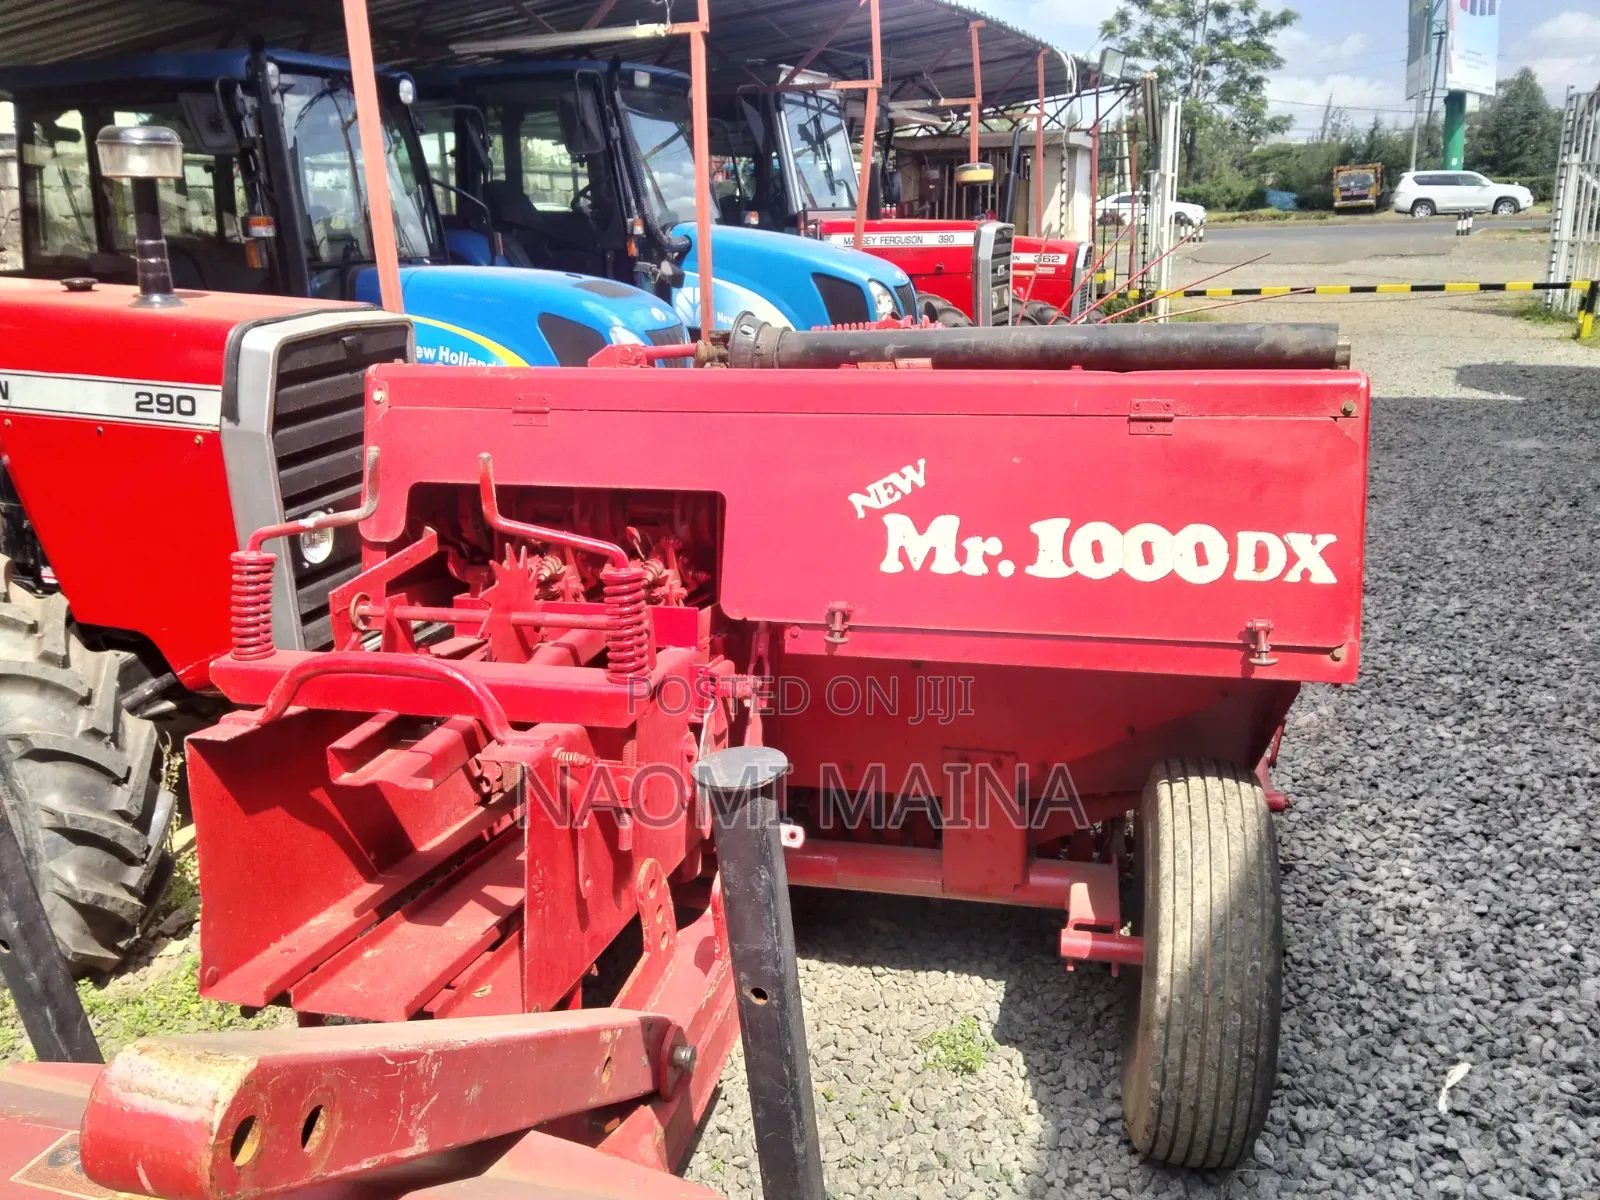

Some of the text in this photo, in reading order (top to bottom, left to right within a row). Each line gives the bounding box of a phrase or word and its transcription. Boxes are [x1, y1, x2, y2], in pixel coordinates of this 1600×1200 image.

[880, 235, 923, 245] FERGUSON
[938, 234, 955, 244] 390
[1033, 254, 1060, 263] 362
[416, 345, 437, 360] ew
[135, 391, 196, 416] 290
[848, 458, 926, 518] NEW
[879, 513, 1016, 577] Mr.
